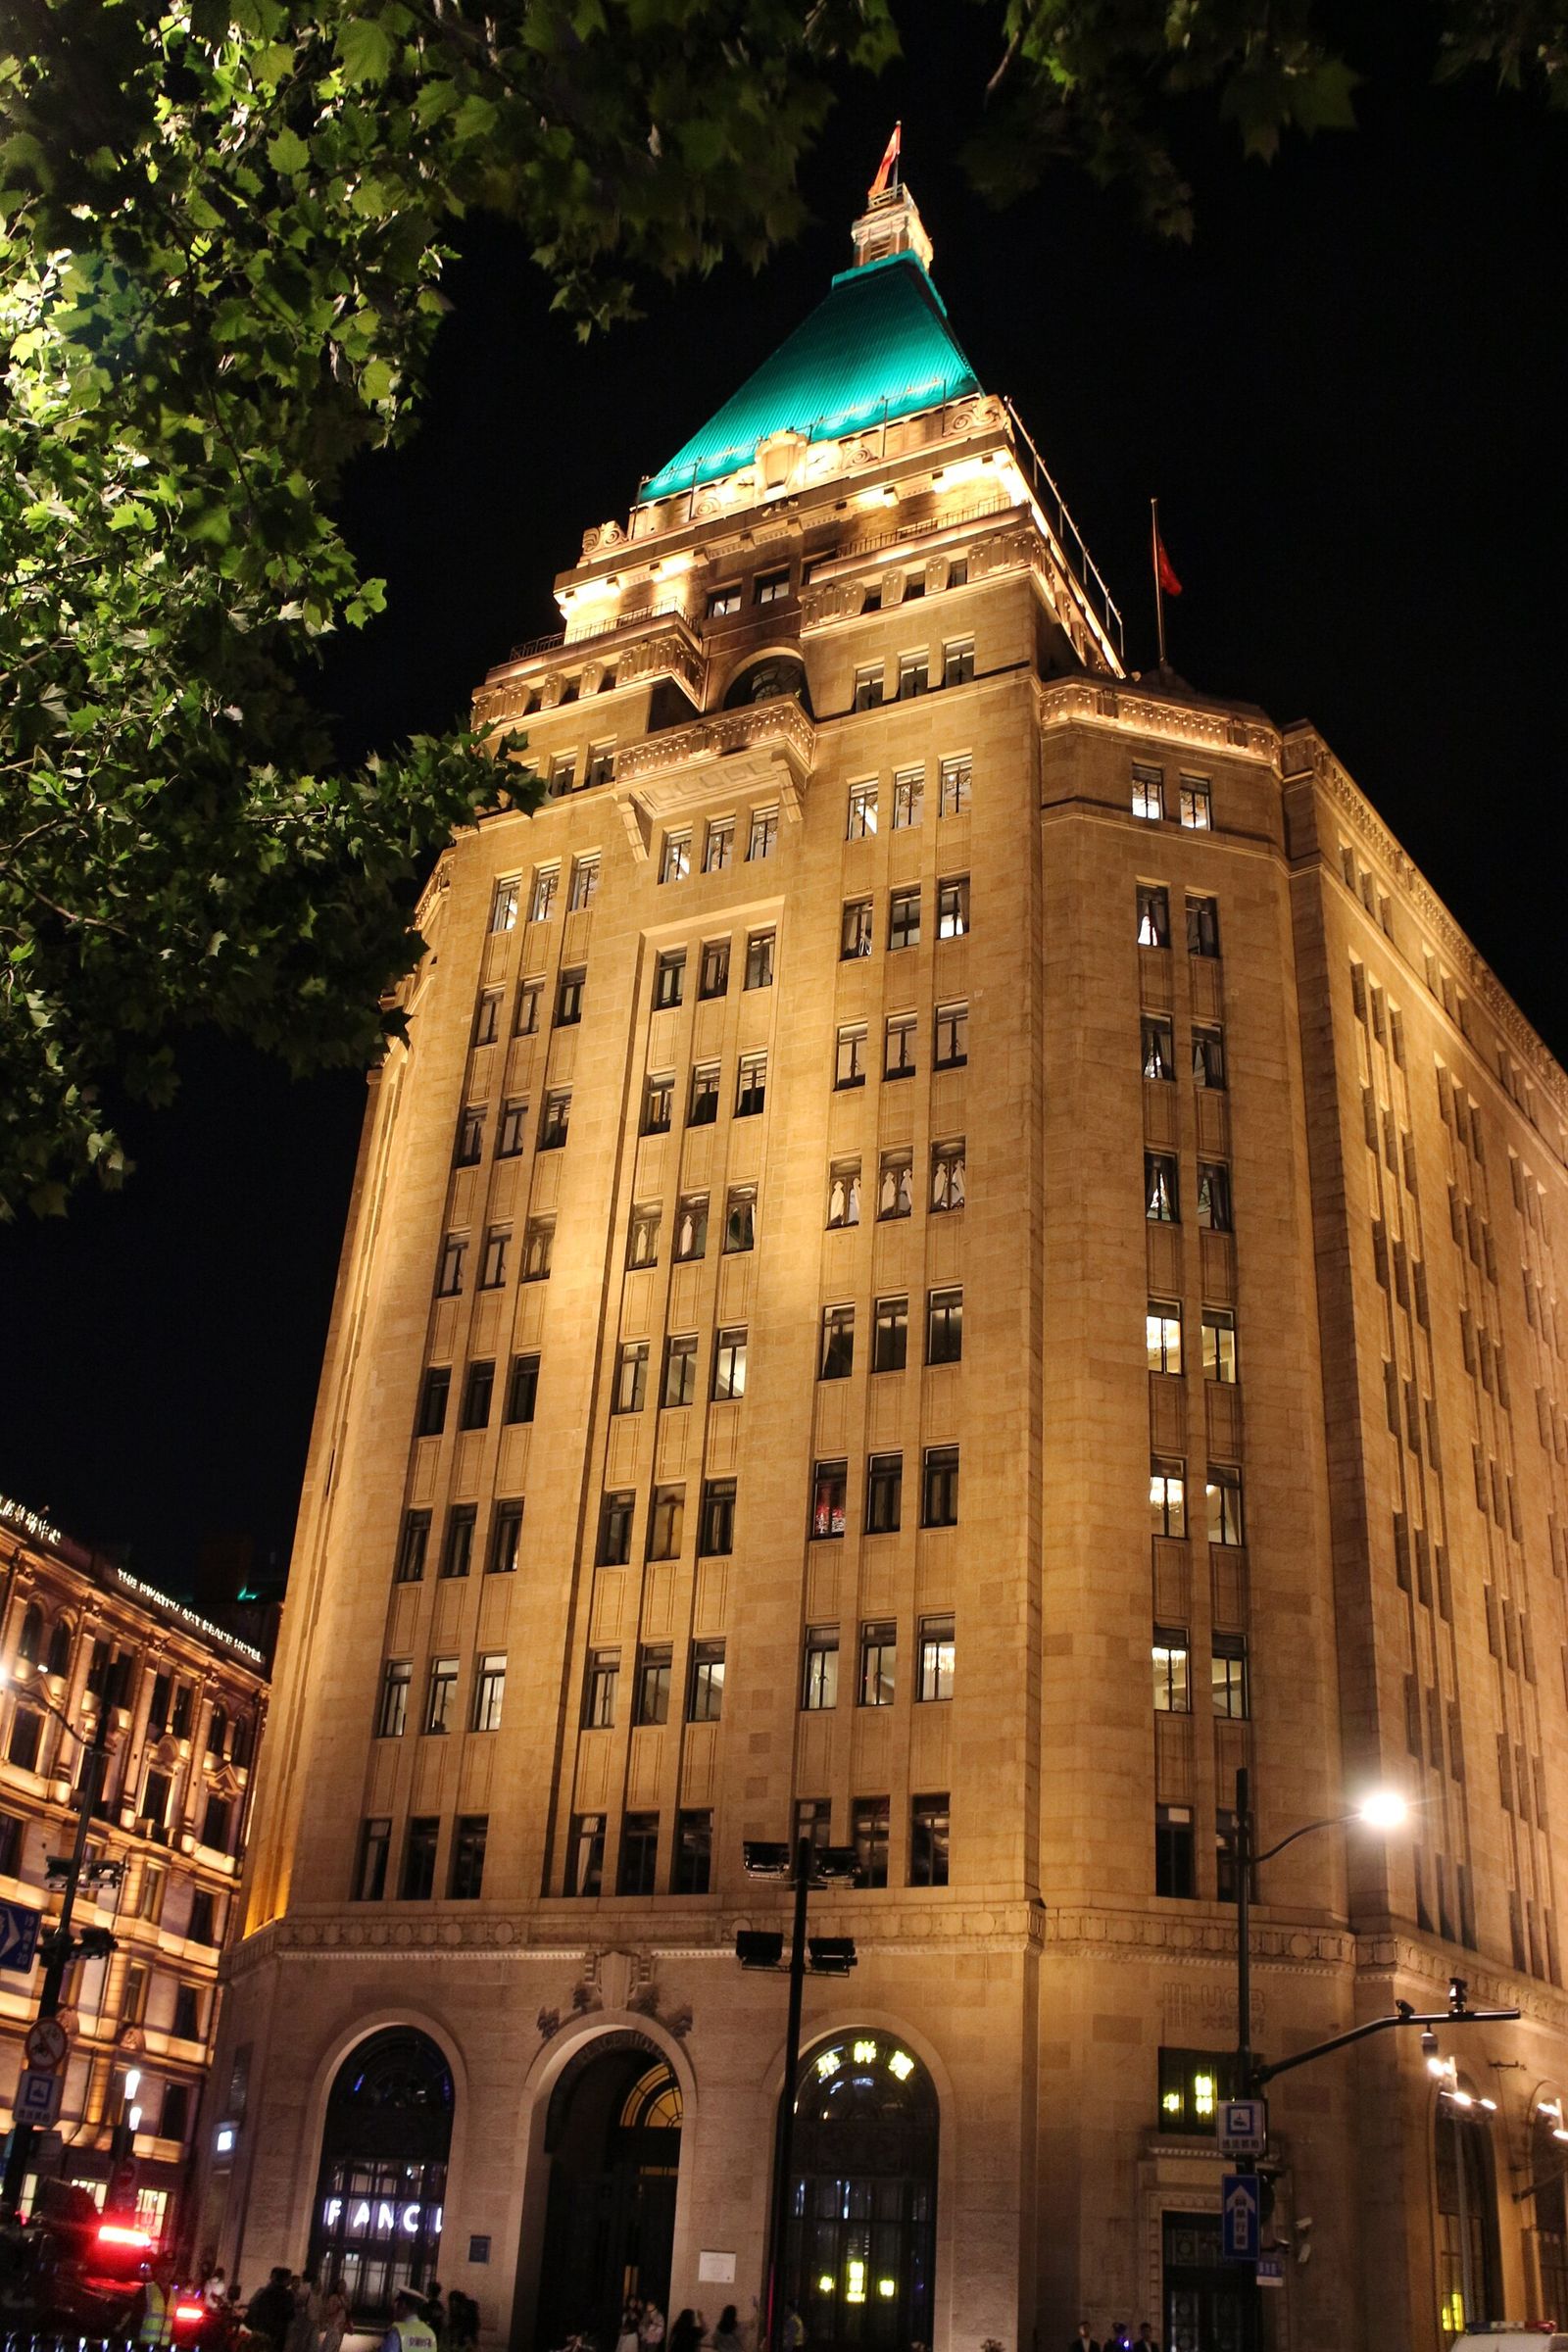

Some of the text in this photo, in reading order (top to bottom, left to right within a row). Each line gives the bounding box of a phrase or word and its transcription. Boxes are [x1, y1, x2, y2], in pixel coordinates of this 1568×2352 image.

[118, 1568, 137, 1590] THE
[181, 1607, 200, 1627] ART
[202, 1619, 233, 1644] PEACE
[234, 1638, 261, 1663] HOTEL
